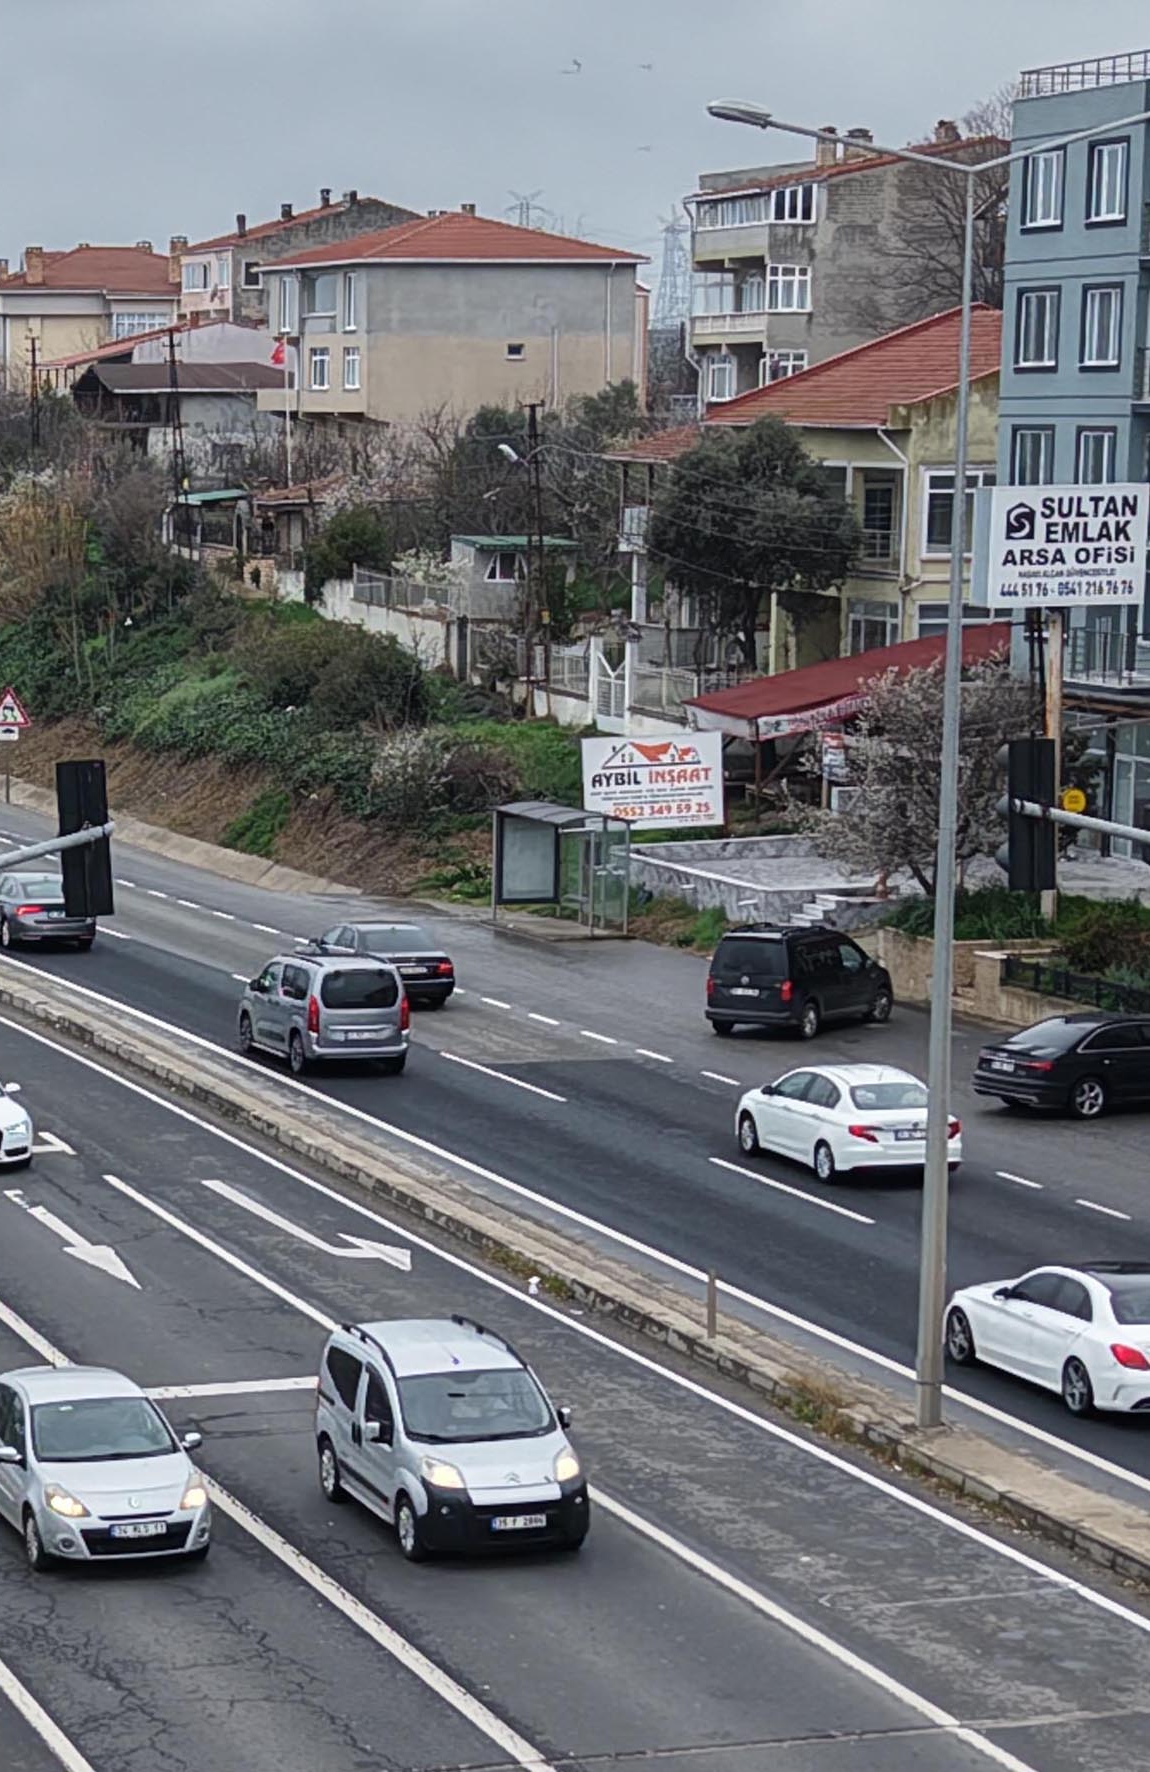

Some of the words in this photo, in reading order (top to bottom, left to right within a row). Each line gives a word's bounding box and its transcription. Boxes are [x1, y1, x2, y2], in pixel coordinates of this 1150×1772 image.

[1040, 494, 1138, 519] SULTAN
[1044, 520, 1132, 543] EMLAK
[1002, 547, 1066, 566] ARSA
[1000, 582, 1019, 597] 444
[1021, 582, 1033, 597] 51
[1036, 582, 1049, 597] 76
[1106, 580, 1119, 595] 76
